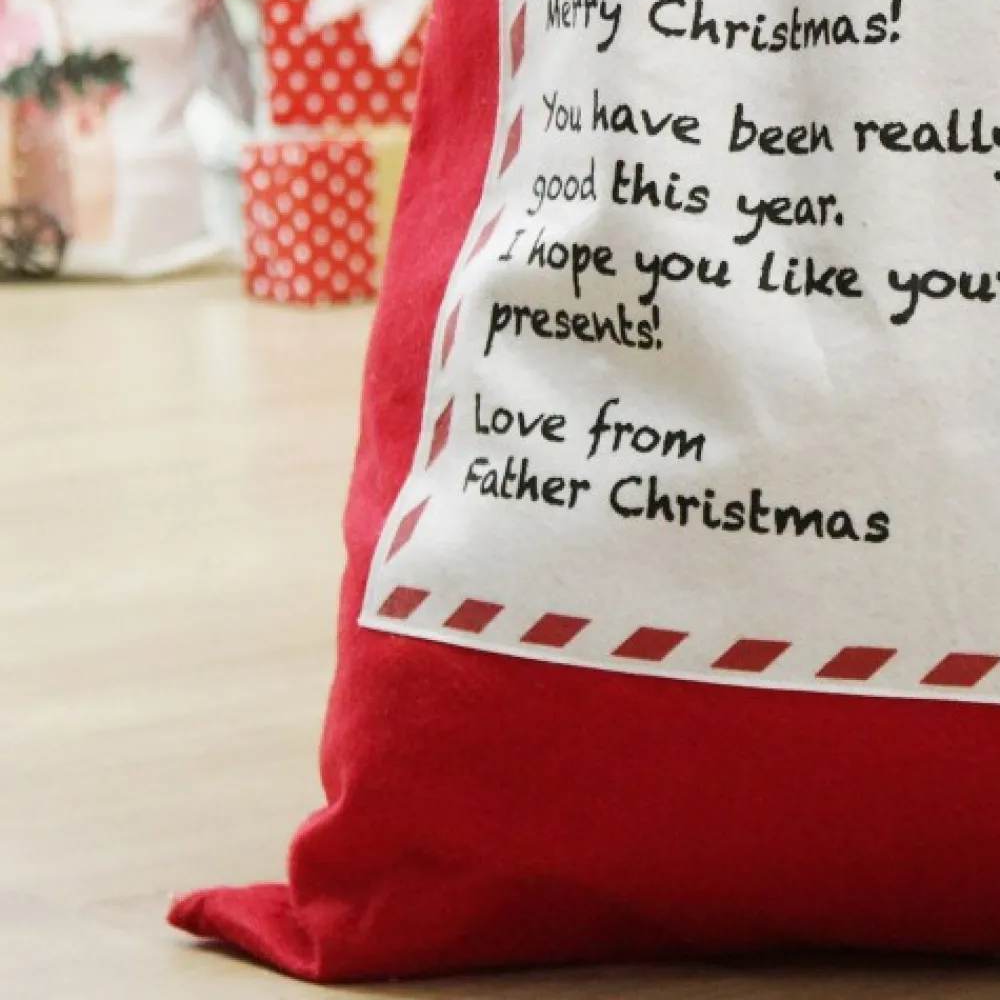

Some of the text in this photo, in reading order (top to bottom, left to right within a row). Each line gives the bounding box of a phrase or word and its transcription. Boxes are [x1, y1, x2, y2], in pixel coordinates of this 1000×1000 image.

[542, 93, 582, 132] You
[592, 88, 702, 146] have
[728, 102, 835, 156] been
[527, 157, 845, 246] good this year.
[499, 224, 524, 264] I
[527, 226, 617, 298] hope
[633, 250, 732, 305] you
[757, 250, 864, 298] like
[484, 302, 663, 356] presents!
[475, 393, 706, 462] Love from
[464, 456, 890, 544] Father Christmas
